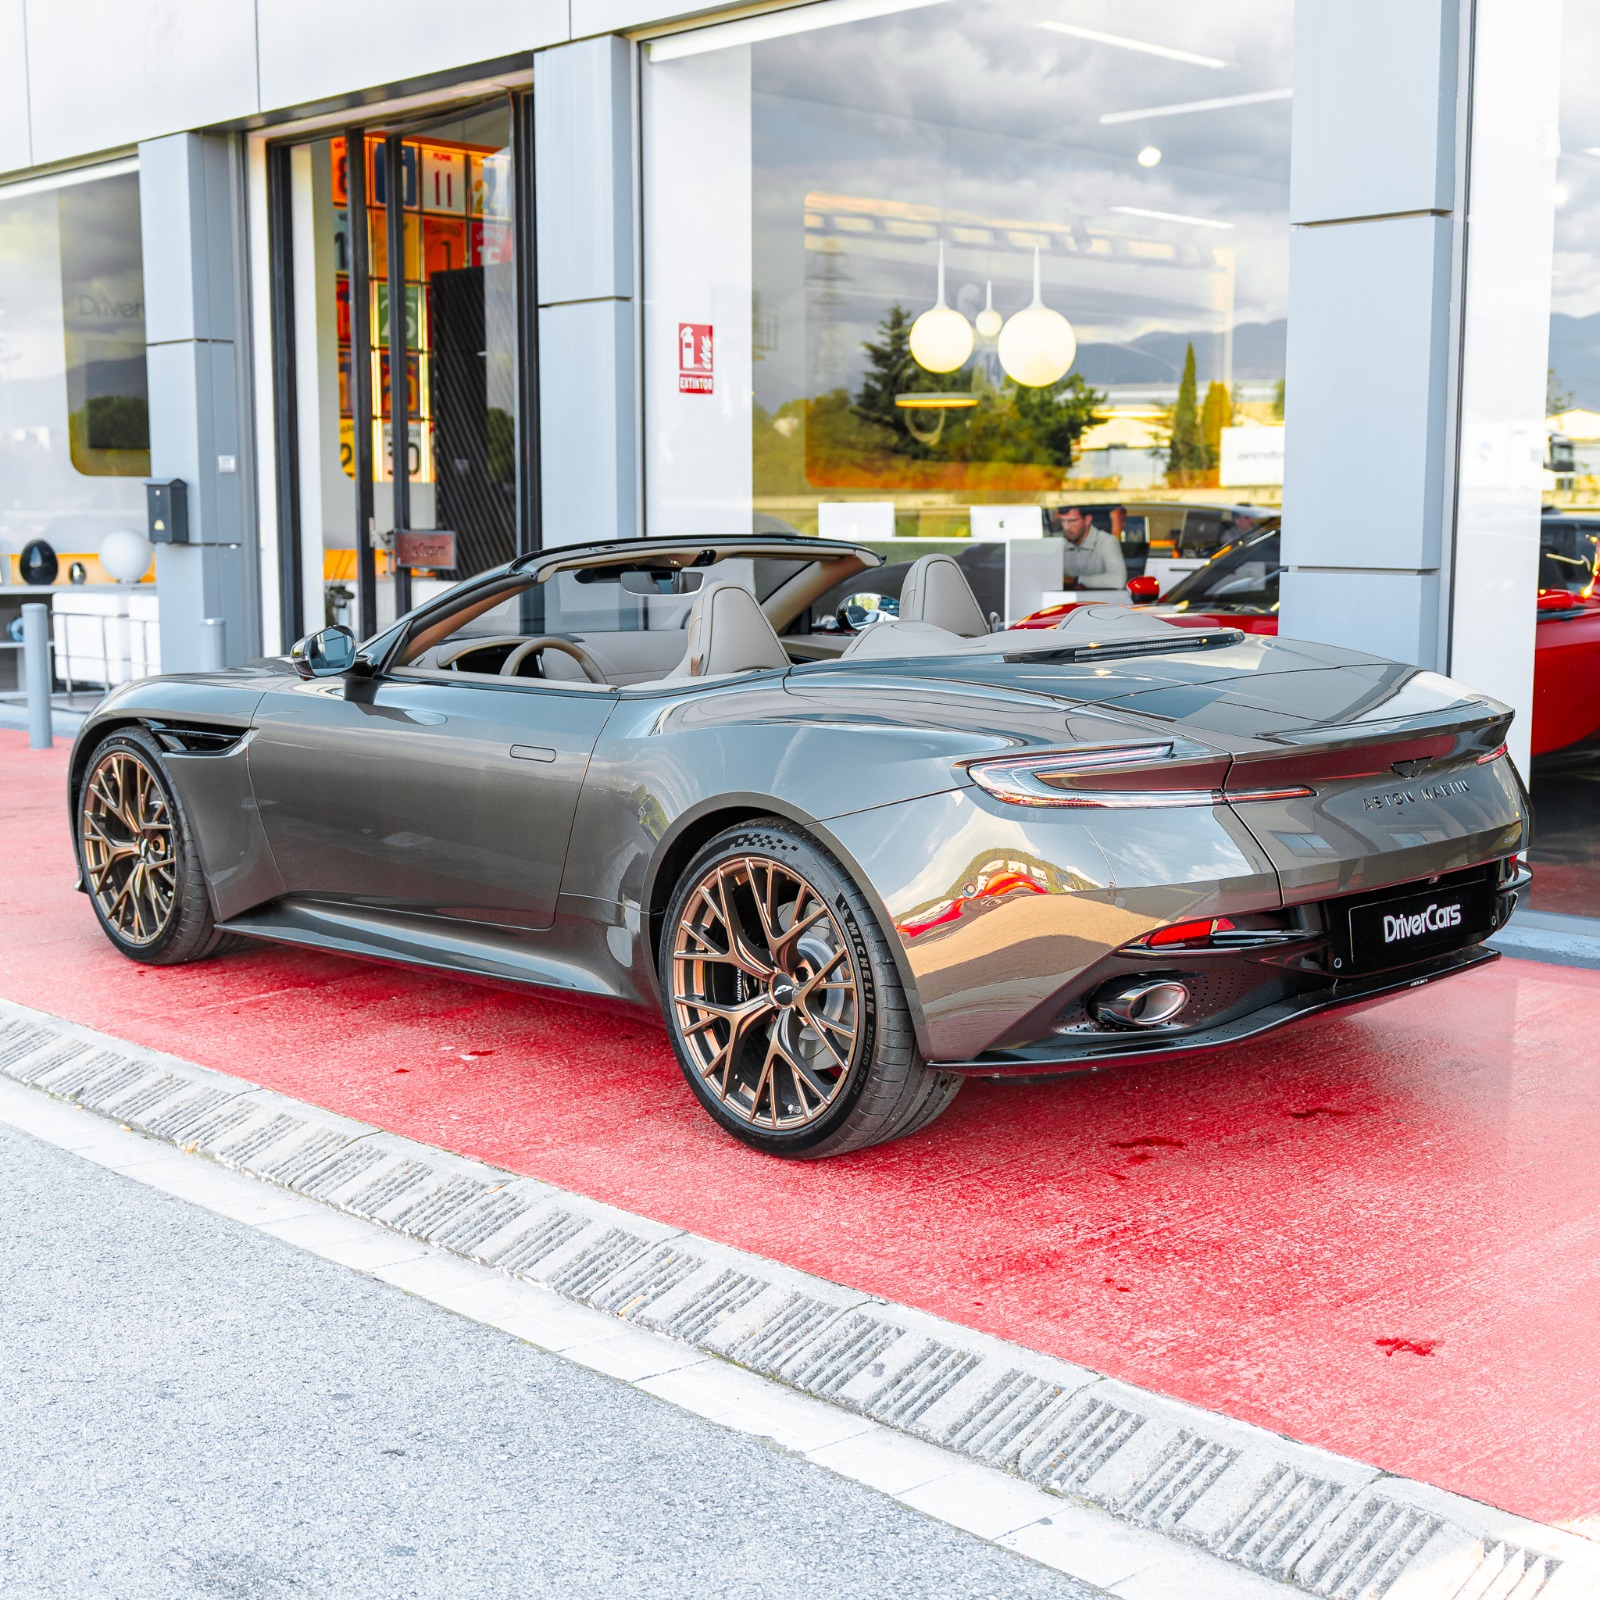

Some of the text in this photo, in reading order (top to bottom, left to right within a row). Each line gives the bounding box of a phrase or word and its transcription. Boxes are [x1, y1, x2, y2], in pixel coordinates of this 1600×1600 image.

[1362, 780, 1471, 811] ASTON MARTIN
[1383, 903, 1462, 943] DriverCars
[847, 921, 875, 1014] MICHELIN
